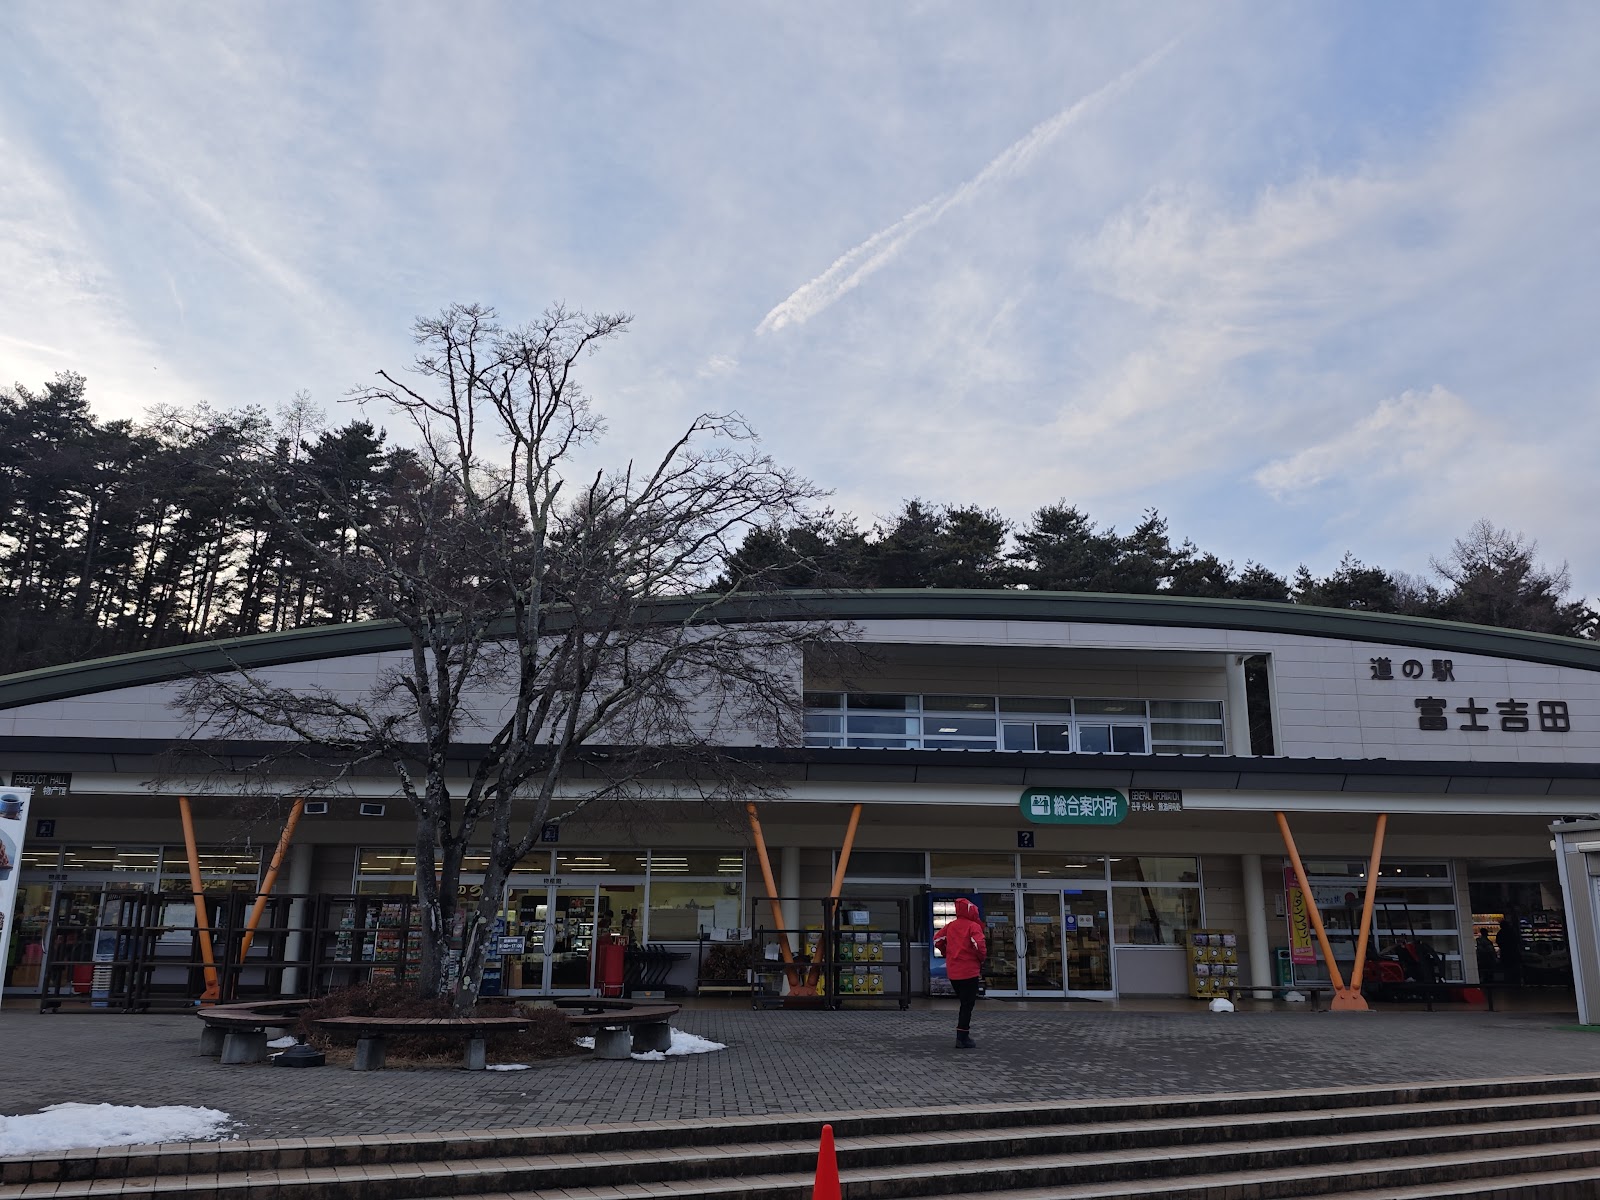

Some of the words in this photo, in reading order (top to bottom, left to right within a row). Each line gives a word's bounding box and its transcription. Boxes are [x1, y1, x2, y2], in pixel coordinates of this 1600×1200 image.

[1370, 656, 1455, 682] 道の駅
[1414, 696, 1571, 733] 富士吉田
[15, 774, 48, 784] PRODUCT
[50, 775, 67, 785] HALL
[1053, 795, 1118, 818] 総合案内所
